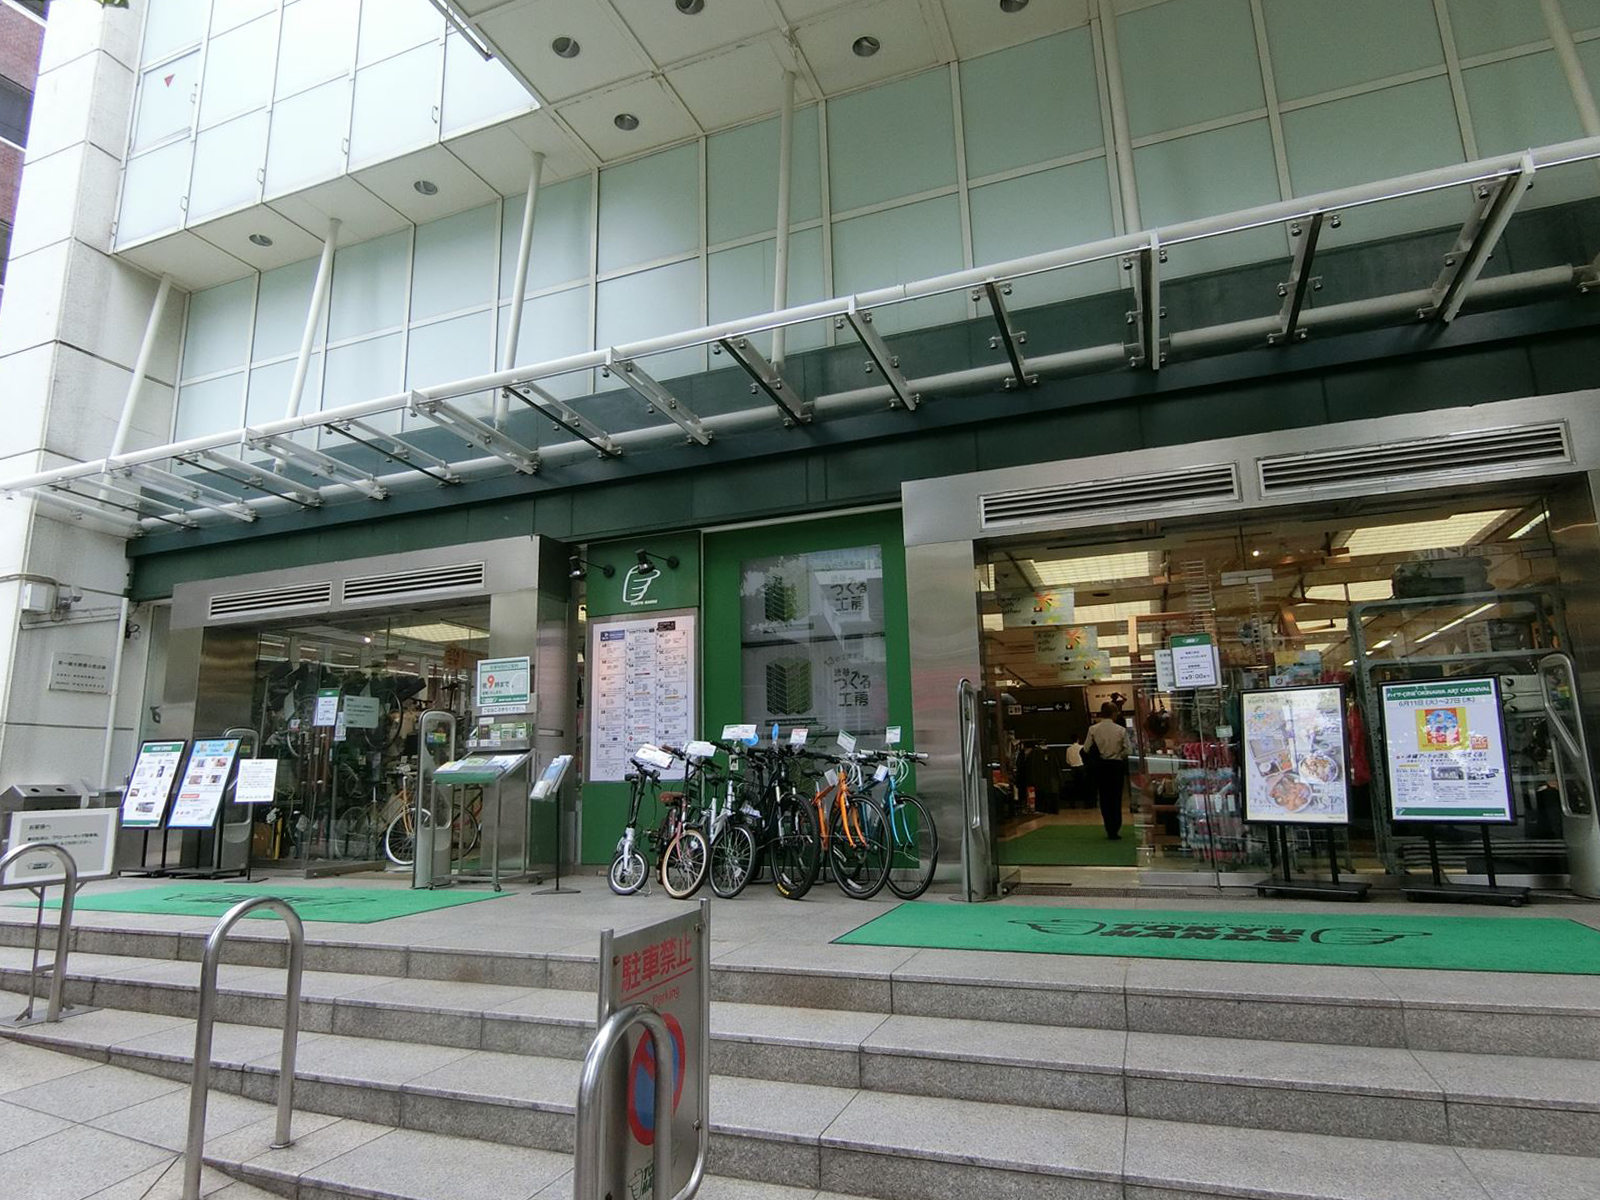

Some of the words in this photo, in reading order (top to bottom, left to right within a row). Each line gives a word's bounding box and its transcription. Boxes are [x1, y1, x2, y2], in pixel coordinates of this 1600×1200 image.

[1447, 687, 1459, 695] ART
[1460, 685, 1490, 694] CARNIVAL
[838, 691, 868, 706] 工房
[1112, 923, 1306, 935] TOKYU
[1099, 930, 1300, 943] HANDS
[621, 931, 694, 992] 駐車禁止
